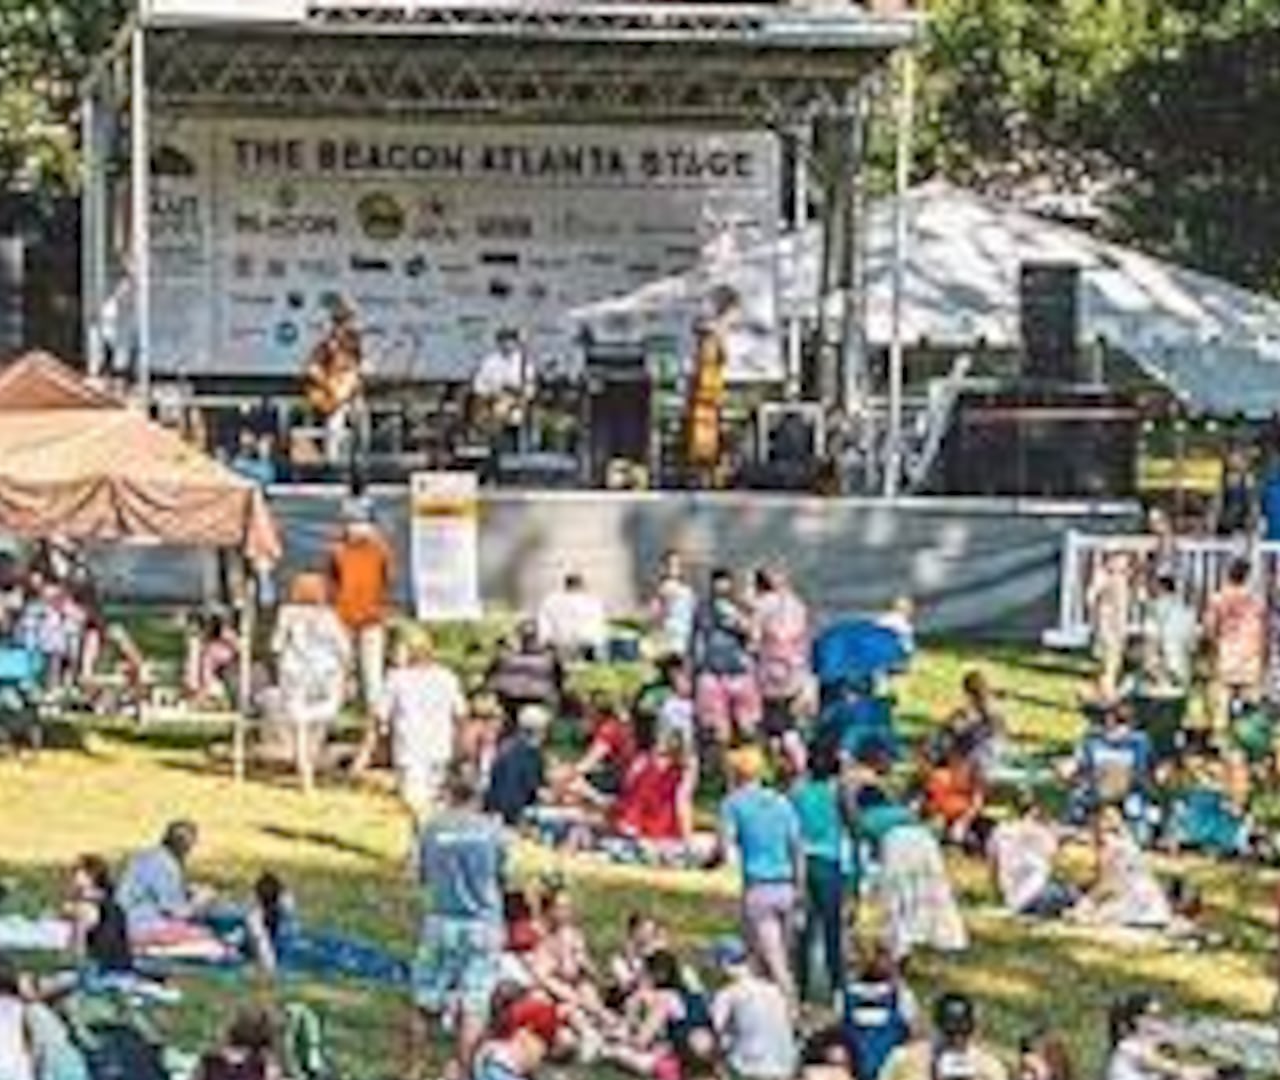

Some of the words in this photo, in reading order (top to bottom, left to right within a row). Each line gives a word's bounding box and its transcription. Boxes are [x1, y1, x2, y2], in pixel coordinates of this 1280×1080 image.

[233, 139, 303, 169] THE
[318, 139, 463, 172] BEACON
[482, 144, 623, 176] ATLANTA
[640, 150, 754, 177] STAGE
